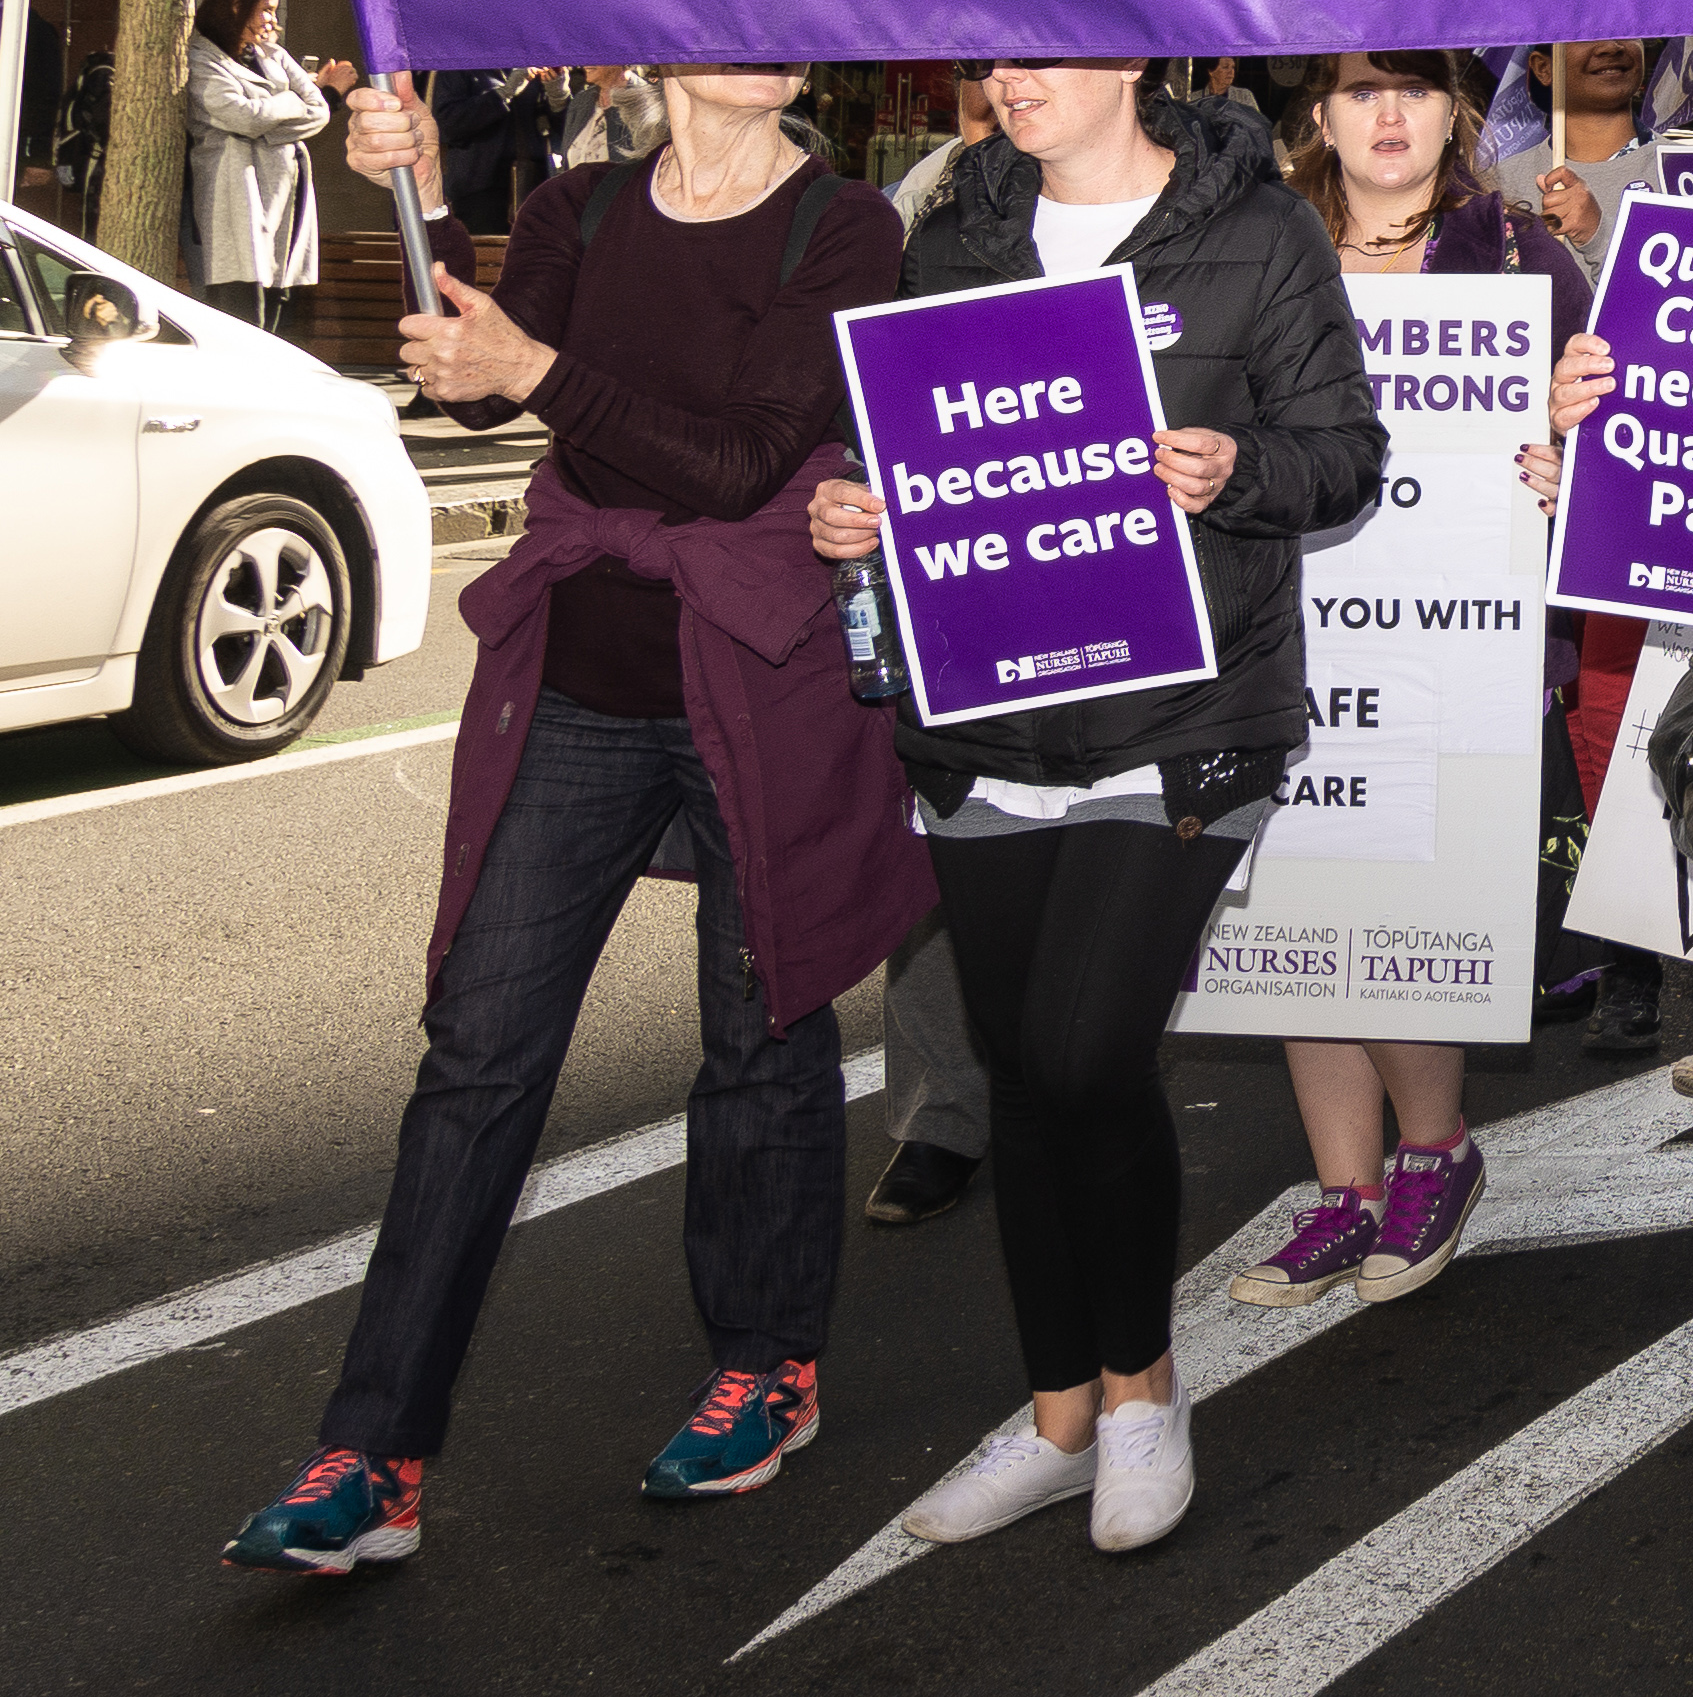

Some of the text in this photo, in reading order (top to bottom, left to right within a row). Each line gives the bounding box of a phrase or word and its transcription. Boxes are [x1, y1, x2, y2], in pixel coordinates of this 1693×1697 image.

[1355, 318, 1532, 357] MBERS
[932, 375, 1084, 434] Here
[1366, 374, 1532, 414] TRONG
[892, 435, 1151, 515] because
[914, 506, 1160, 582] we care
[1312, 597, 1522, 631] YOU WITH
[1657, 621, 1684, 637] WE
[1036, 655, 1081, 670] NURSES
[1086, 647, 1130, 662] TAPUHI
[1305, 687, 1380, 728] AFE
[1271, 775, 1367, 807] CARE
[1208, 923, 1339, 944] NEW ZEALAND
[1363, 925, 1495, 953] TŌPŪTANGA
[1205, 946, 1337, 976] NURSES
[1360, 955, 1494, 985] TAPUHI
[1204, 978, 1336, 998] ORGANISATION
[1360, 987, 1492, 1004] KAITIAKI O AOTEAROA
